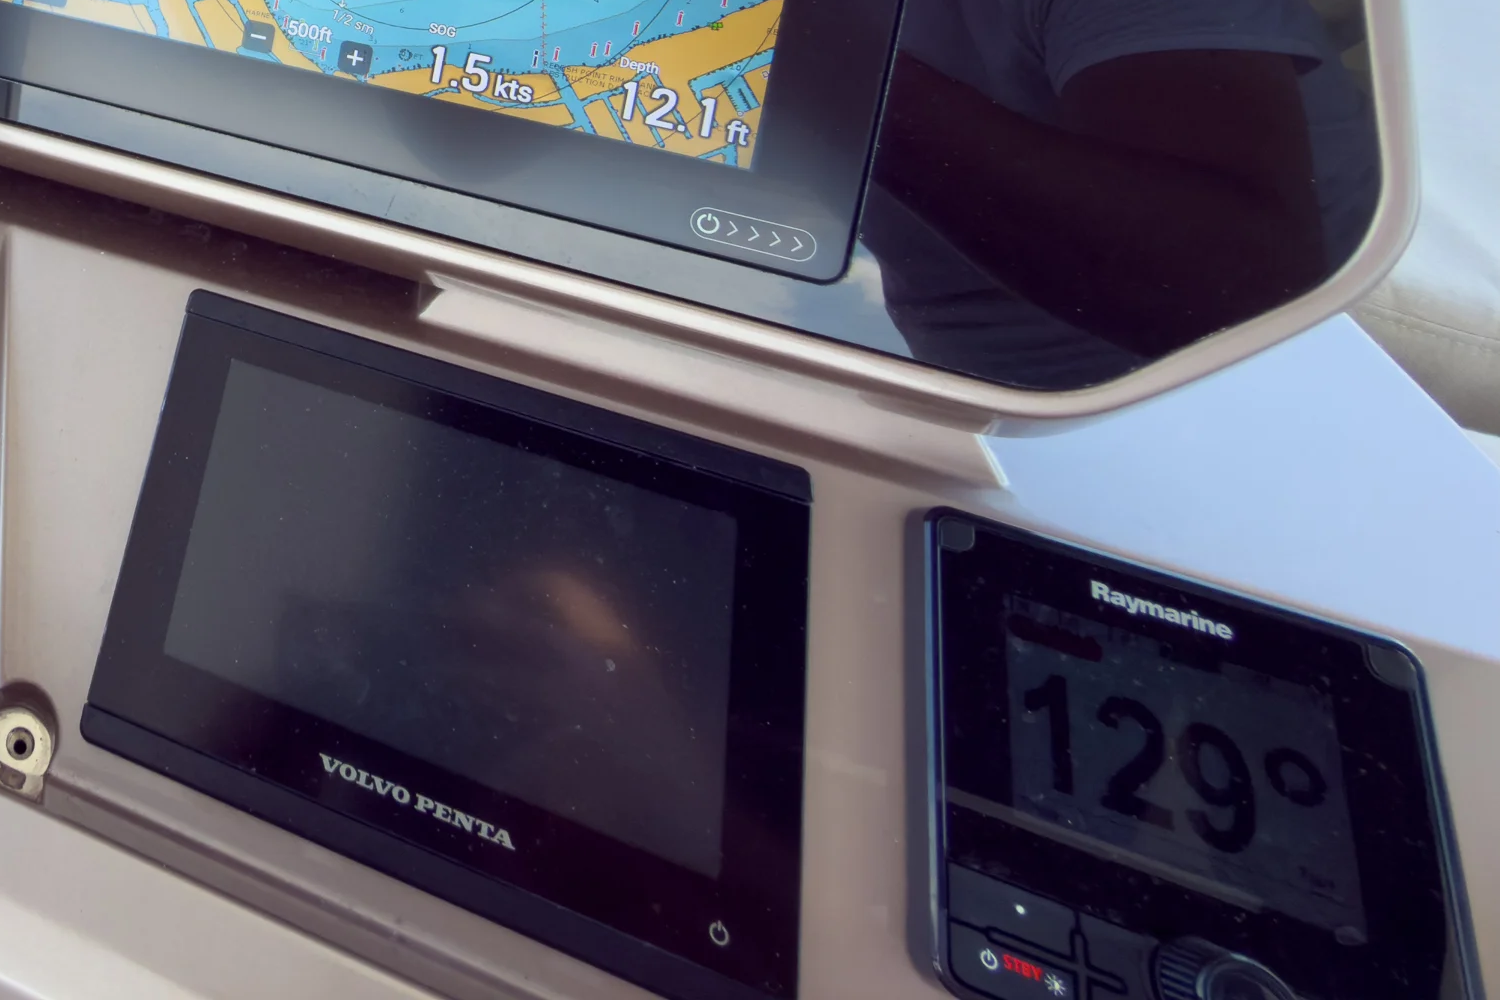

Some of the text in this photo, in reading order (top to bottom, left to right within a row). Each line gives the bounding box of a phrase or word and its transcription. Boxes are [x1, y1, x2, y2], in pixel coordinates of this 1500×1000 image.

[332, 9, 375, 35] 1/2 sm
[428, 22, 456, 38] SOG
[429, 44, 534, 104] 1.5 kts
[619, 56, 660, 75] Depth
[622, 81, 717, 138] 12.1
[726, 120, 750, 147] ft
[1090, 579, 1234, 641] Raymarine
[319, 752, 516, 851] VOLVO PENTA
[1002, 953, 1043, 982] STBY
